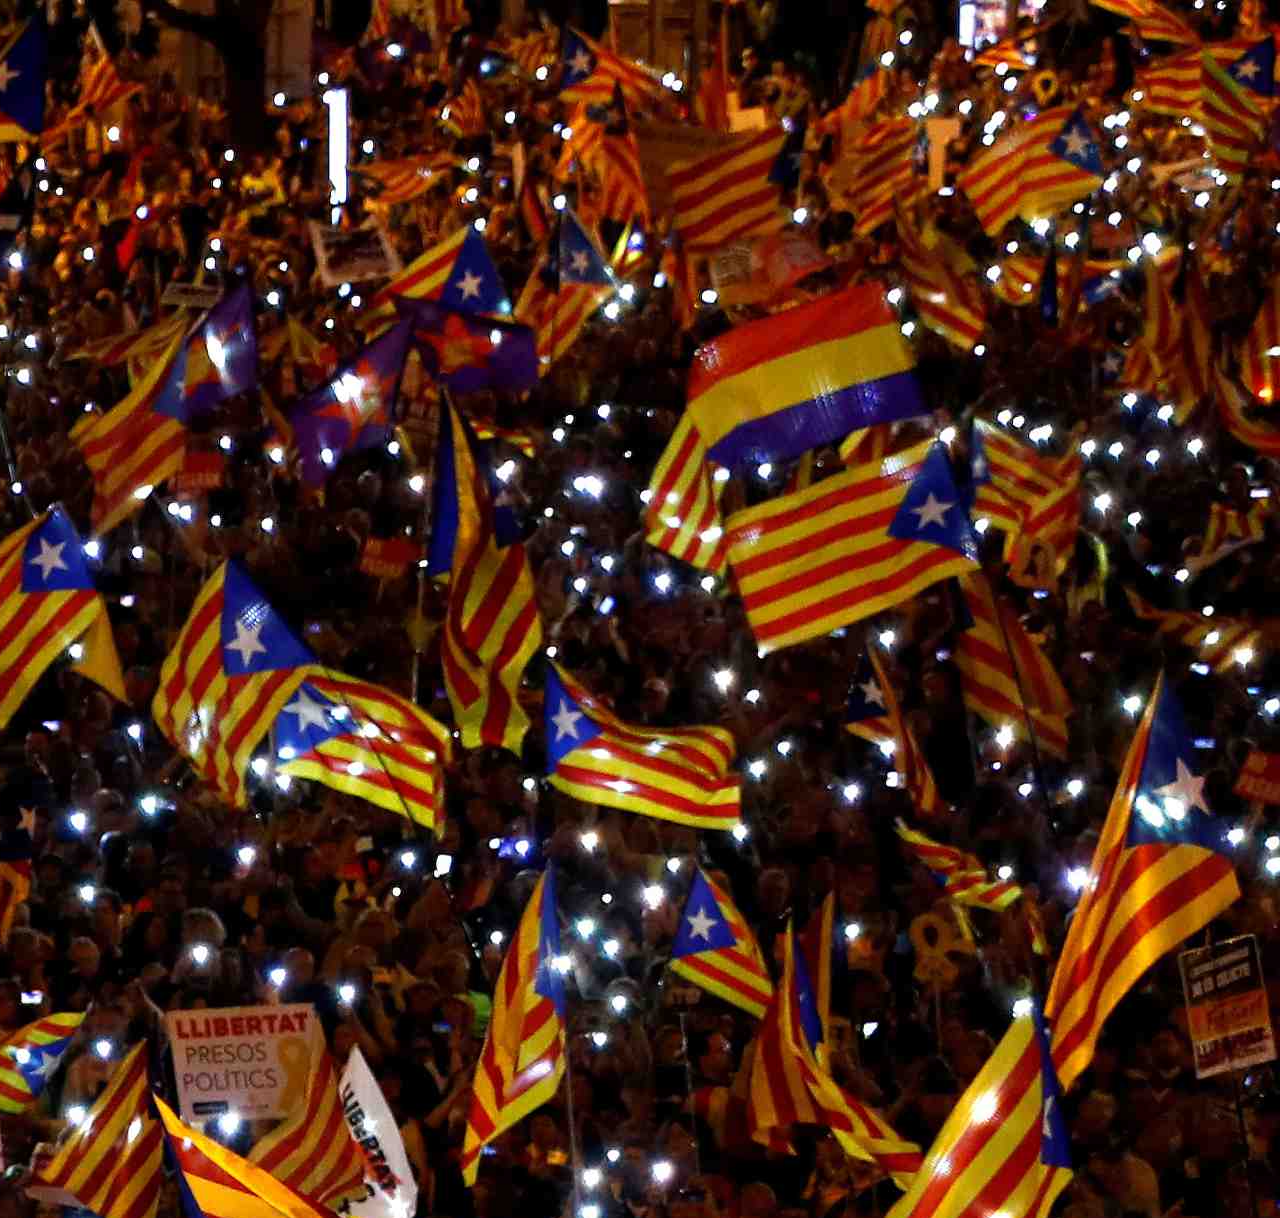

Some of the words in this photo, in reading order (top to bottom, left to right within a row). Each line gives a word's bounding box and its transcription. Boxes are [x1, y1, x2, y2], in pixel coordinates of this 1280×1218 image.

[175, 1008, 307, 1040] LLIBERTAT
[186, 1041, 267, 1065] PRESOS
[183, 1067, 278, 1091] POLÍTICS
